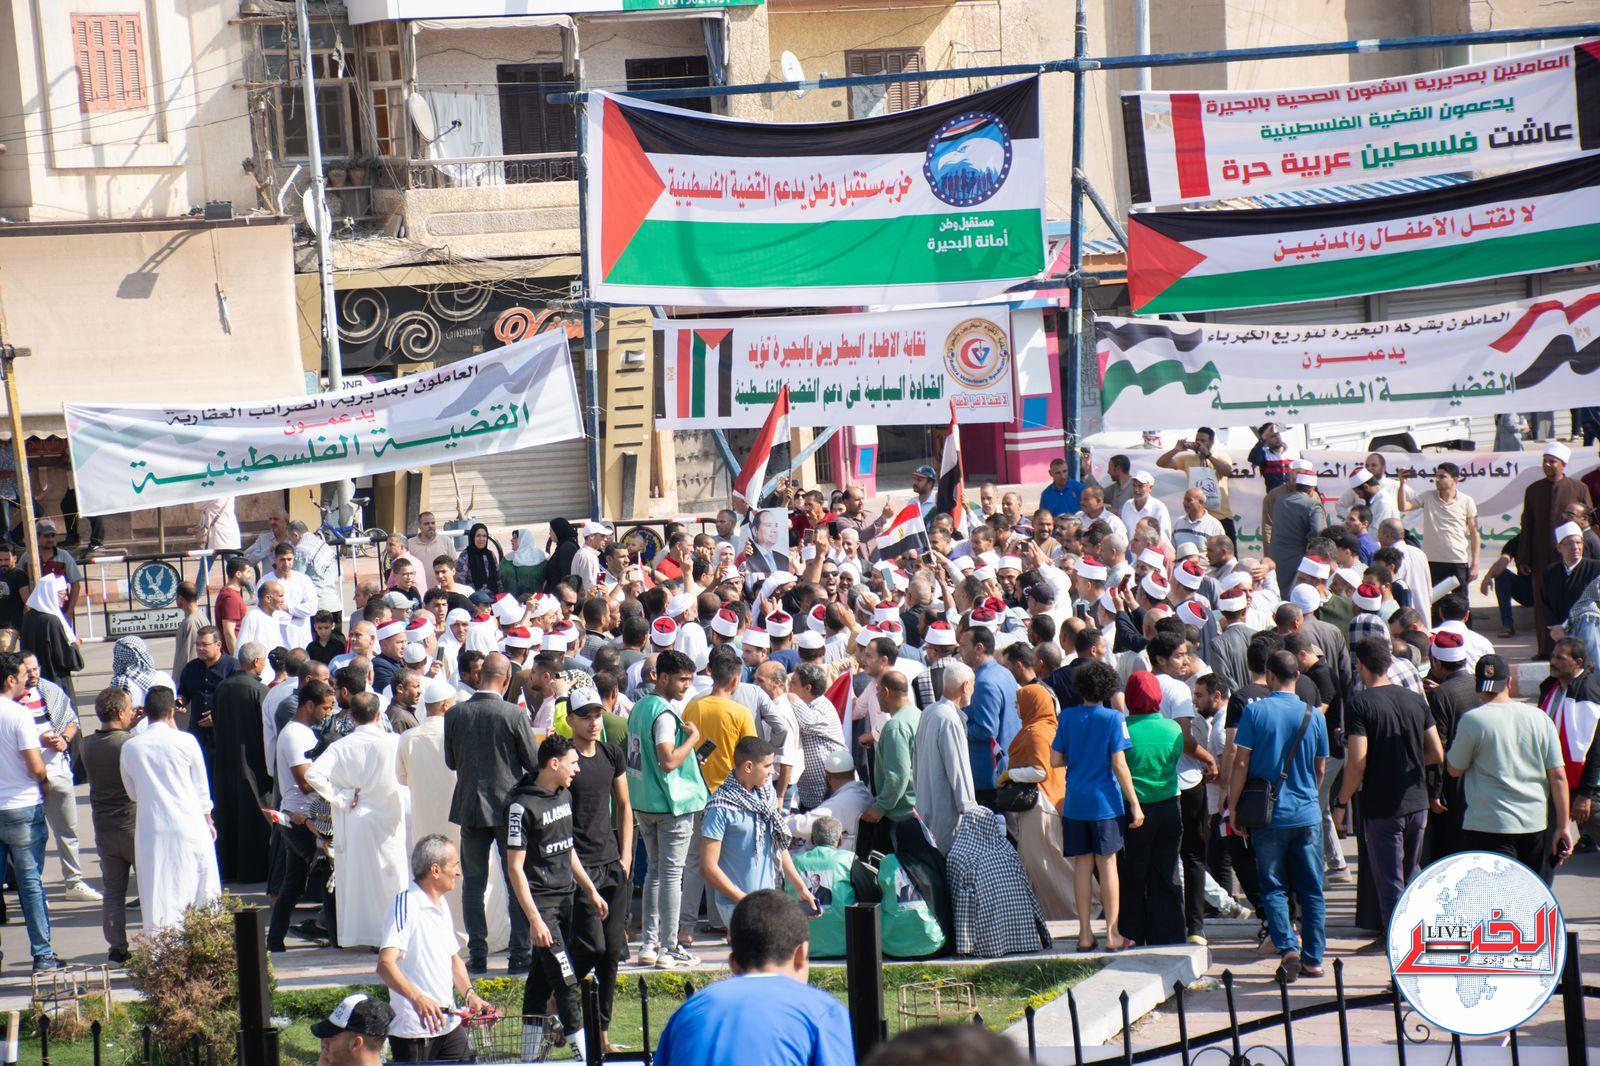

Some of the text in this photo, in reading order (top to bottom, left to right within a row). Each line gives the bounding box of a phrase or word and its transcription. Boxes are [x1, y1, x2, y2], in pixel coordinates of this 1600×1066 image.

[1415, 69, 1487, 91] بمديرية
[1493, 55, 1570, 82] العاملين
[1206, 97, 1271, 116] بالبحيرة
[1276, 89, 1340, 108] الصحية
[1260, 96, 1515, 141] يدعمون القضية الفلسطينية
[1223, 117, 1573, 185] عاشت فلسطين عربية حرة
[668, 167, 913, 211] حزب مستقبل وطن يدعم القضية الفلسطينية
[939, 216, 995, 232] مستقبل وطن
[1460, 207, 1515, 238] لقتل
[1521, 204, 1537, 223] لا
[927, 229, 1008, 253] أمانة البحيرة
[1273, 229, 1365, 262] والمدنيين
[1207, 329, 1269, 344] الكهرباء
[1446, 312, 1511, 334] العاملون
[773, 335, 813, 368] بالبحيرة
[816, 332, 865, 367] البيطريين
[903, 331, 926, 364] نقابة
[1301, 346, 1408, 369] يدعمون
[413, 364, 479, 395] العاملون
[865, 374, 906, 408] السياسية
[910, 373, 944, 407] القيادة
[1208, 370, 1517, 417] القضية الفلسطينية
[823, 382, 843, 411] دعم
[283, 408, 376, 437] يدعمون
[130, 403, 531, 495] القضية الفلسطينية
[1456, 461, 1519, 482] العاملو
[112, 611, 179, 625] مرور البحيرة
[112, 624, 147, 634] BEHEIRA
